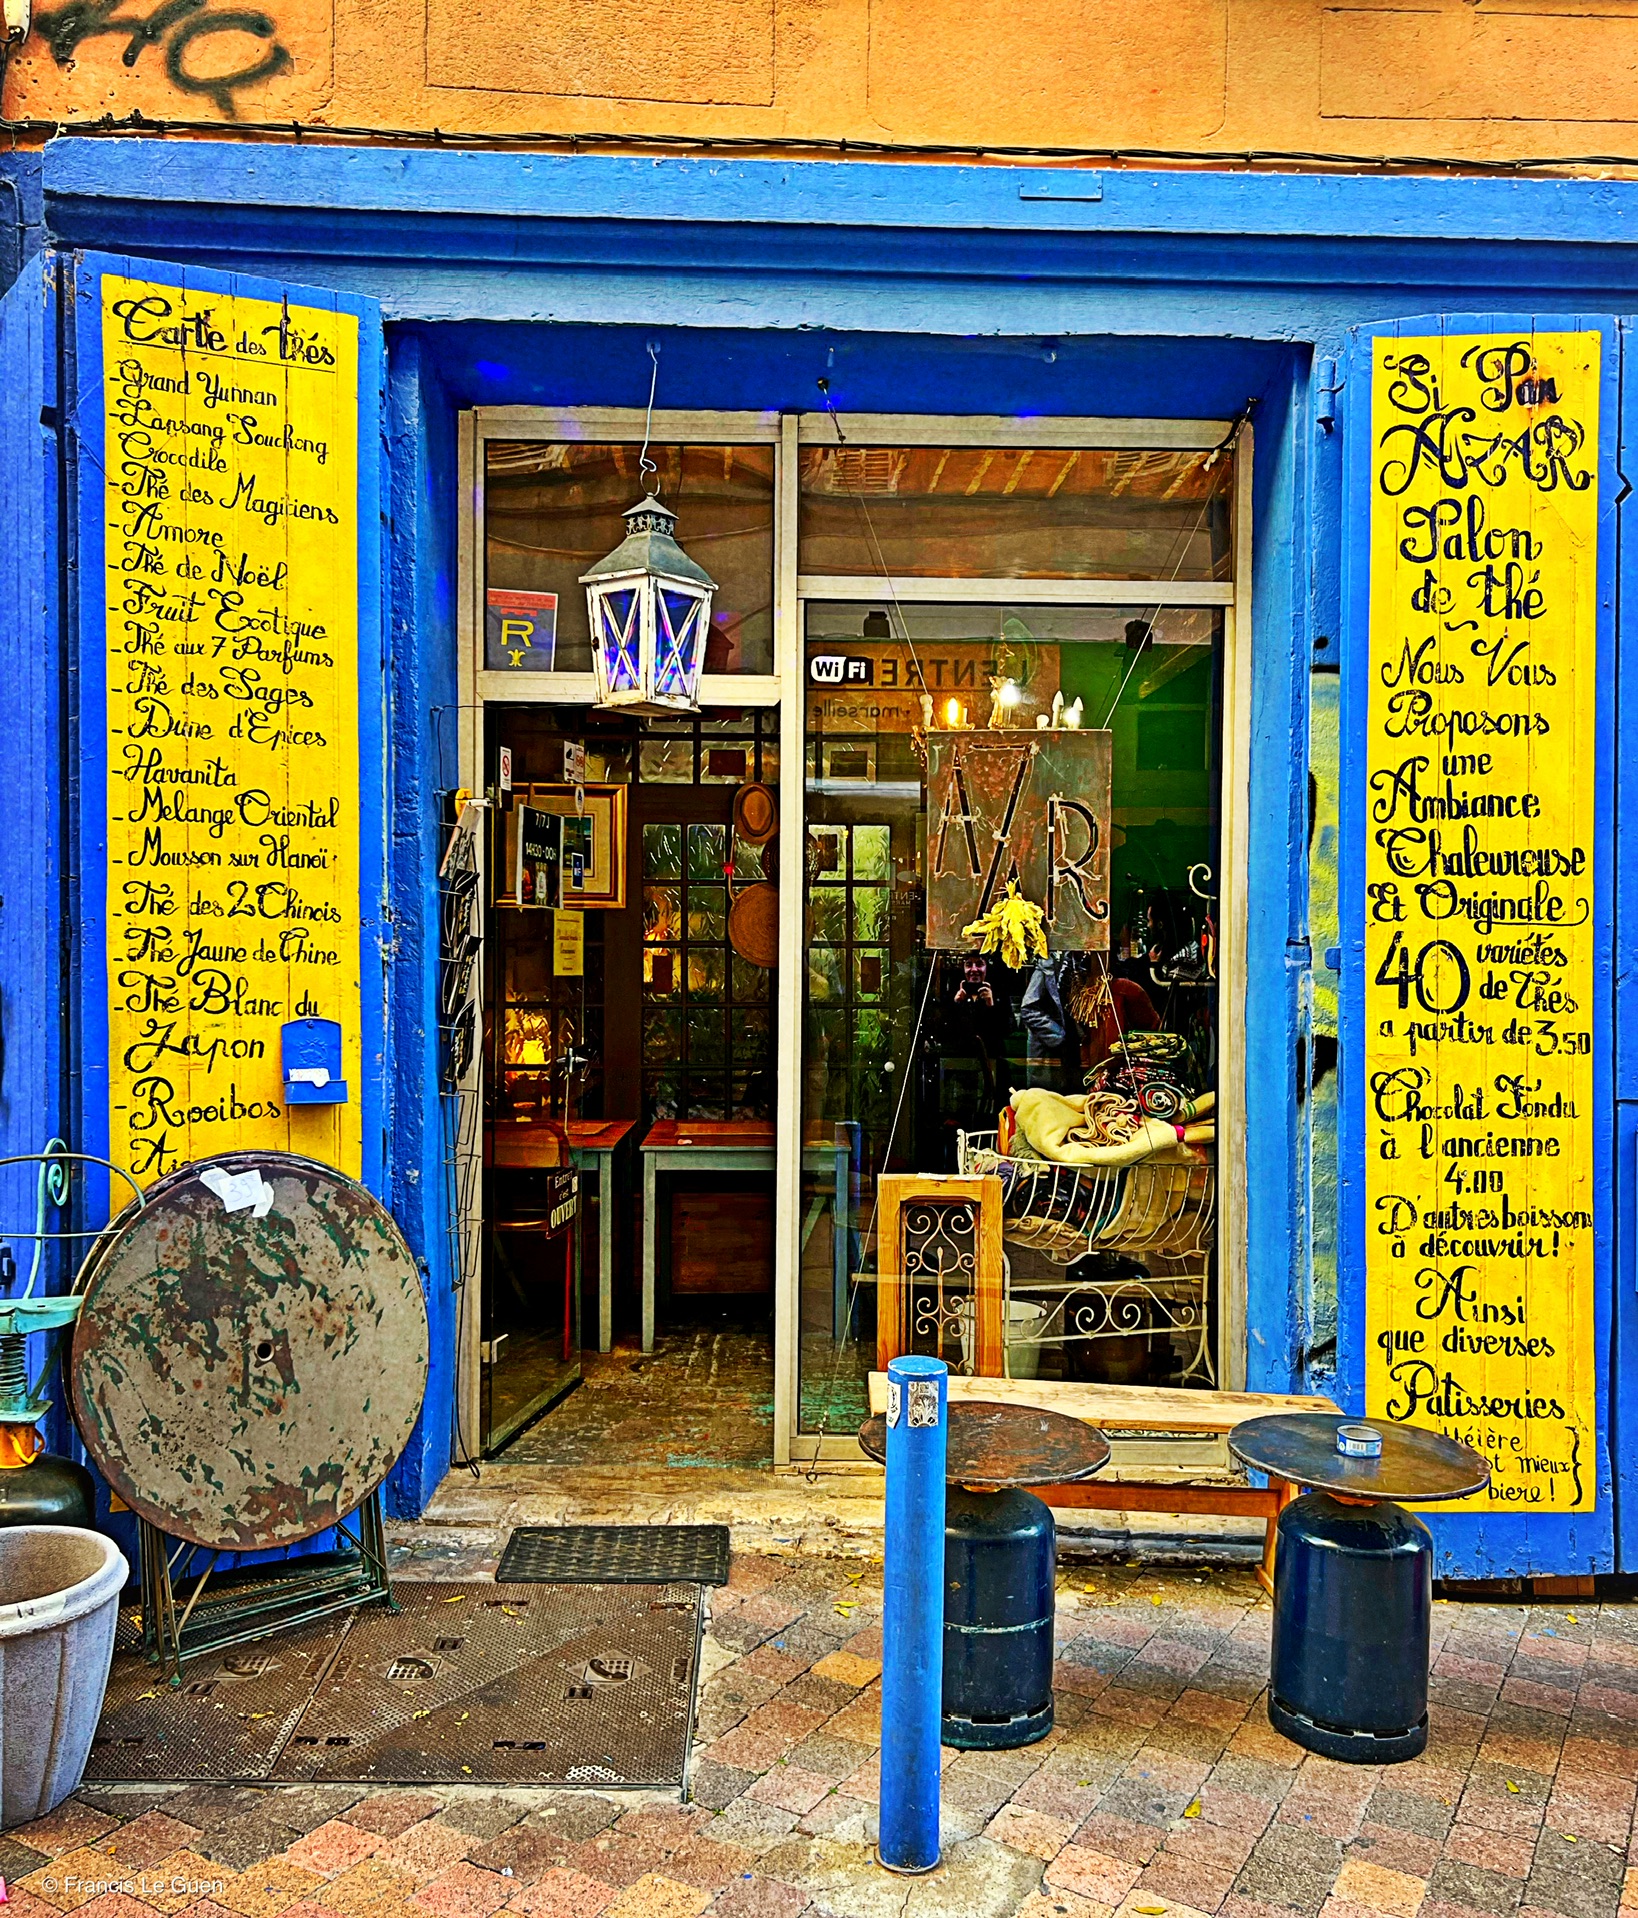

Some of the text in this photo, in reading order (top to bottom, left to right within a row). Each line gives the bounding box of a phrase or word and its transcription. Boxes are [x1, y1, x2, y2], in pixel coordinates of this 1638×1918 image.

[112, 296, 228, 351] Carte
[236, 331, 267, 356] des
[197, 372, 277, 409] Yunnan
[1384, 354, 1449, 414] Si
[118, 431, 230, 473] Crocodile
[180, 481, 214, 506] des
[1400, 494, 1543, 563] Salon
[176, 555, 206, 580] de
[211, 549, 288, 591] Noël
[1412, 569, 1456, 614] de
[208, 588, 327, 648] Exotique
[501, 620, 534, 647] R
[174, 639, 207, 655] aux
[211, 636, 226, 658] 7
[232, 636, 334, 675] Parfums
[1381, 635, 1557, 688] Nous Vous
[181, 672, 219, 700] des
[220, 666, 314, 714] Sages
[1384, 689, 1550, 753] Proposons
[1442, 753, 1494, 776] une
[234, 789, 339, 828] Oriental
[1370, 756, 1541, 823] Ambiance
[228, 852, 260, 868] sur
[1375, 824, 1586, 878] Chaleureuse
[190, 890, 224, 916] des
[227, 881, 256, 918] 2
[255, 882, 341, 923] Chinois
[1367, 879, 1589, 935] Et Originale
[177, 928, 247, 977] Jaune
[252, 938, 276, 962] de
[279, 927, 341, 966] Chine
[1476, 932, 1568, 967] variétés
[189, 969, 283, 1016] Blanc
[295, 990, 320, 1017] du
[1375, 931, 1470, 1015] 40
[1480, 971, 1508, 999] de
[124, 1018, 265, 1074] Japon
[1404, 1011, 1497, 1056] partir
[1502, 1018, 1533, 1045] de
[1534, 1020, 1591, 1056] 3.50
[1370, 1067, 1580, 1122] Chocolat Fondu
[1380, 1129, 1401, 1159] à
[551, 1195, 577, 1228] OUVERT
[1391, 1235, 1405, 1258] à
[1415, 1265, 1526, 1325] Ainsi
[1377, 1326, 1555, 1365] que diverses
[1515, 1455, 1570, 1474] mieux
